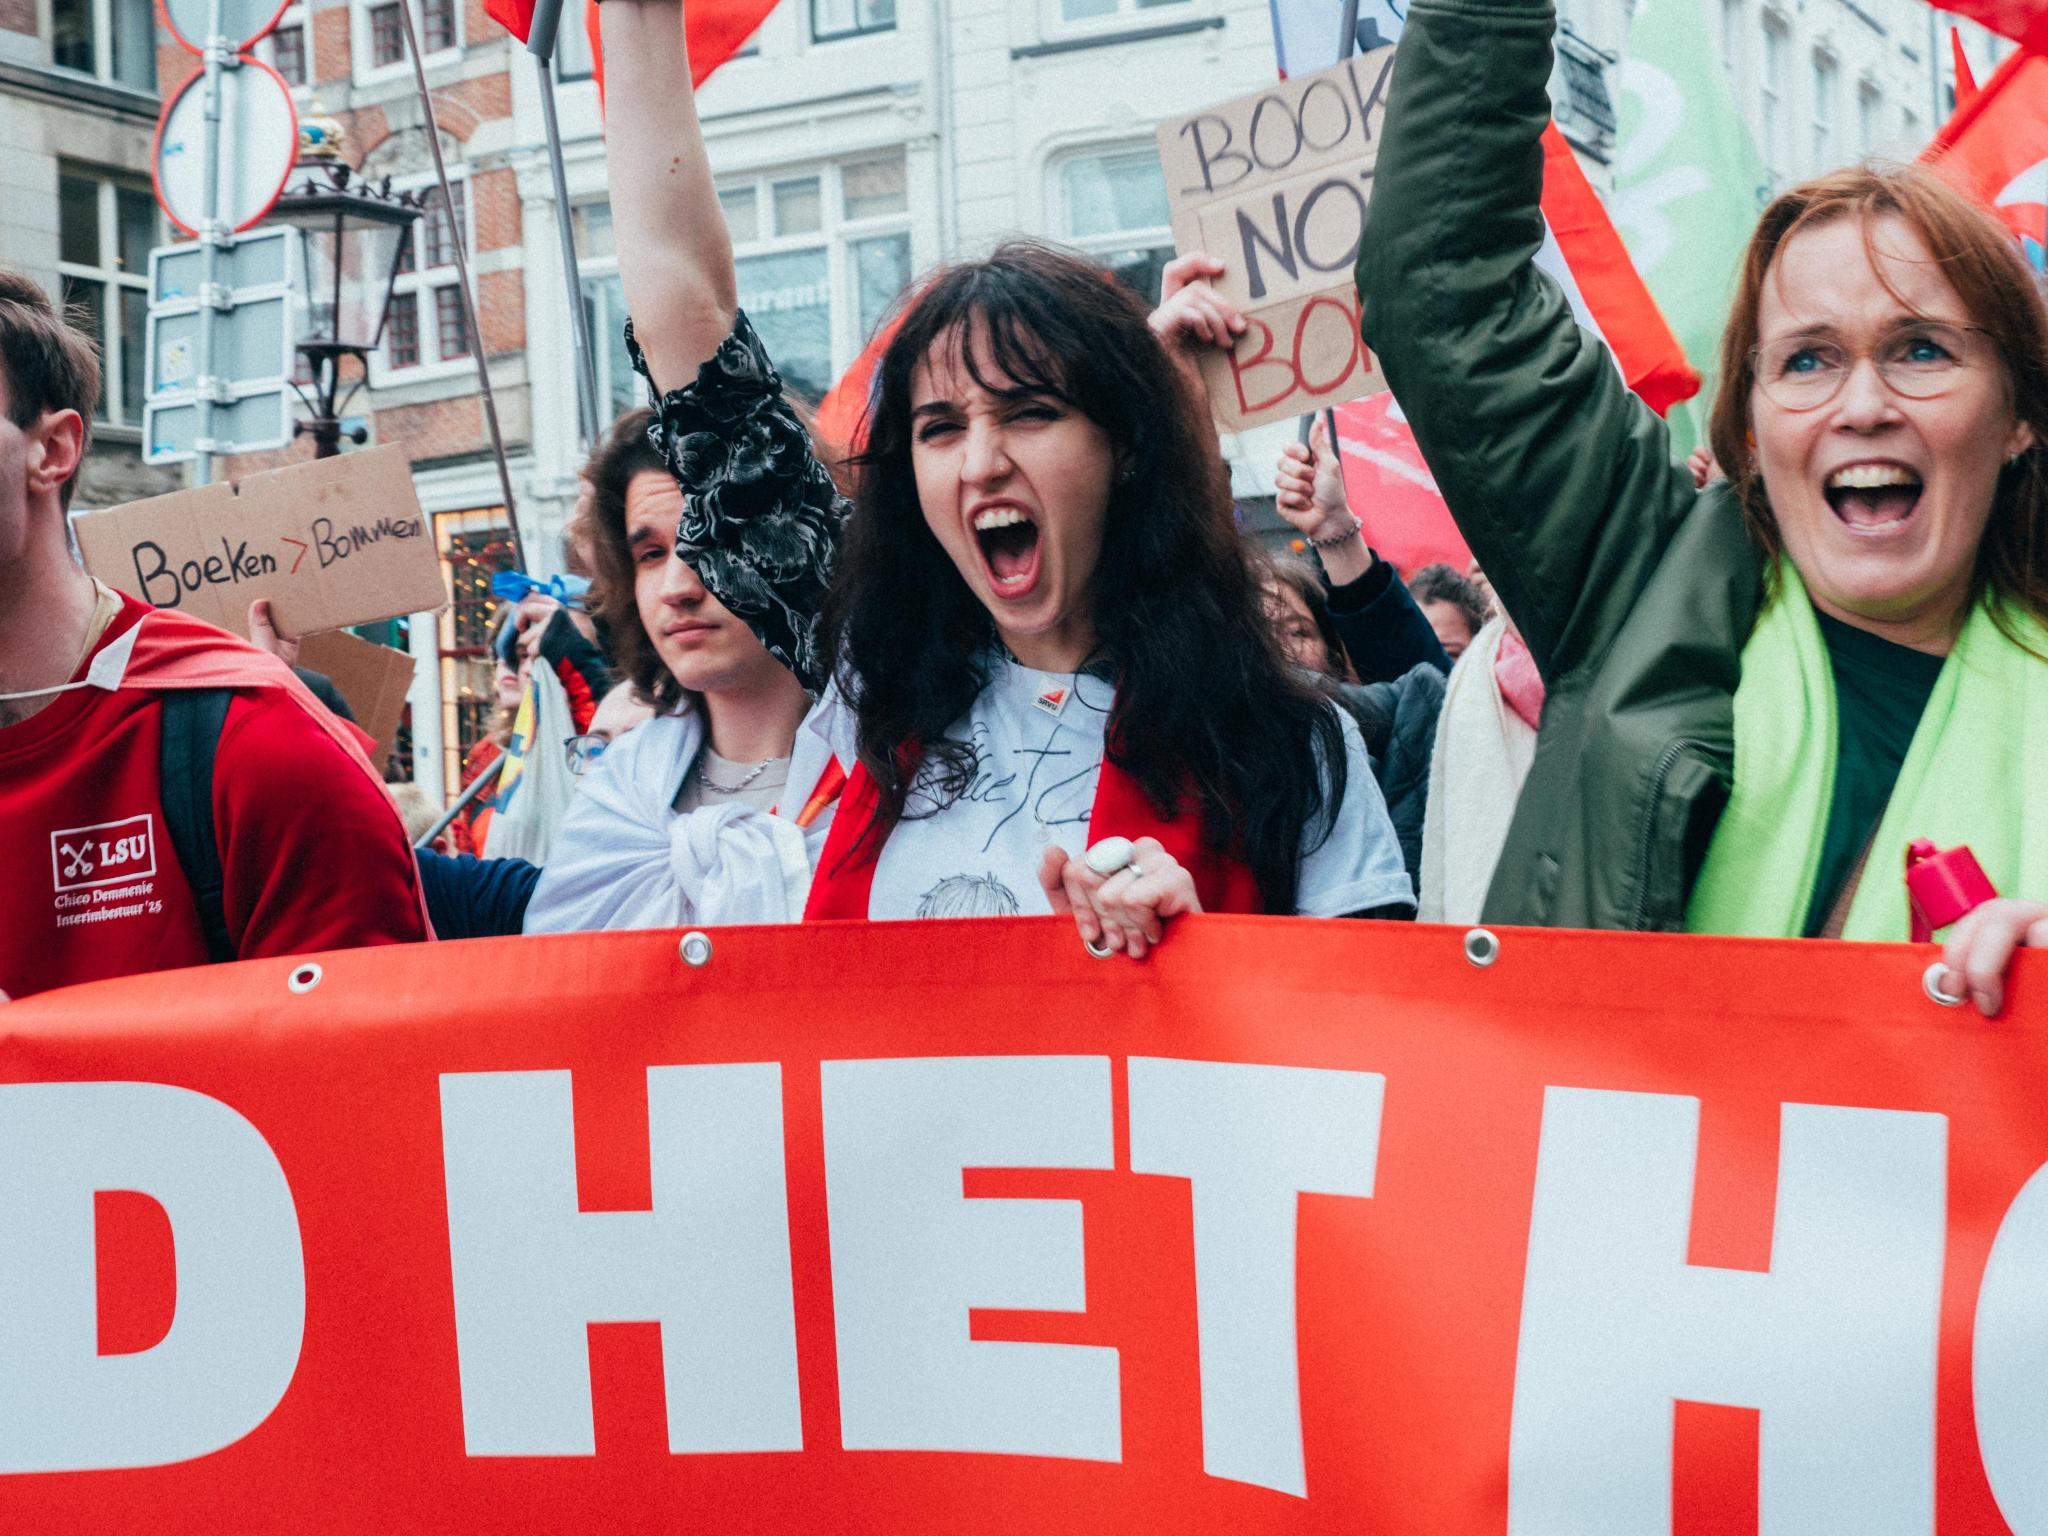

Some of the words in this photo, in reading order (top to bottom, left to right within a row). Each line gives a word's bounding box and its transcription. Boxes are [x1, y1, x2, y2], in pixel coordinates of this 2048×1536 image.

[132, 537, 276, 608] Boeken
[312, 517, 420, 568] Bommen
[99, 834, 147, 867] LSU
[54, 893, 92, 910] Chico
[92, 881, 154, 904] Demmenie
[56, 903, 144, 928] Interimbestuur
[145, 899, 163, 914] '25
[438, 1054, 1387, 1499] HET
[1507, 1084, 2048, 1536] H
